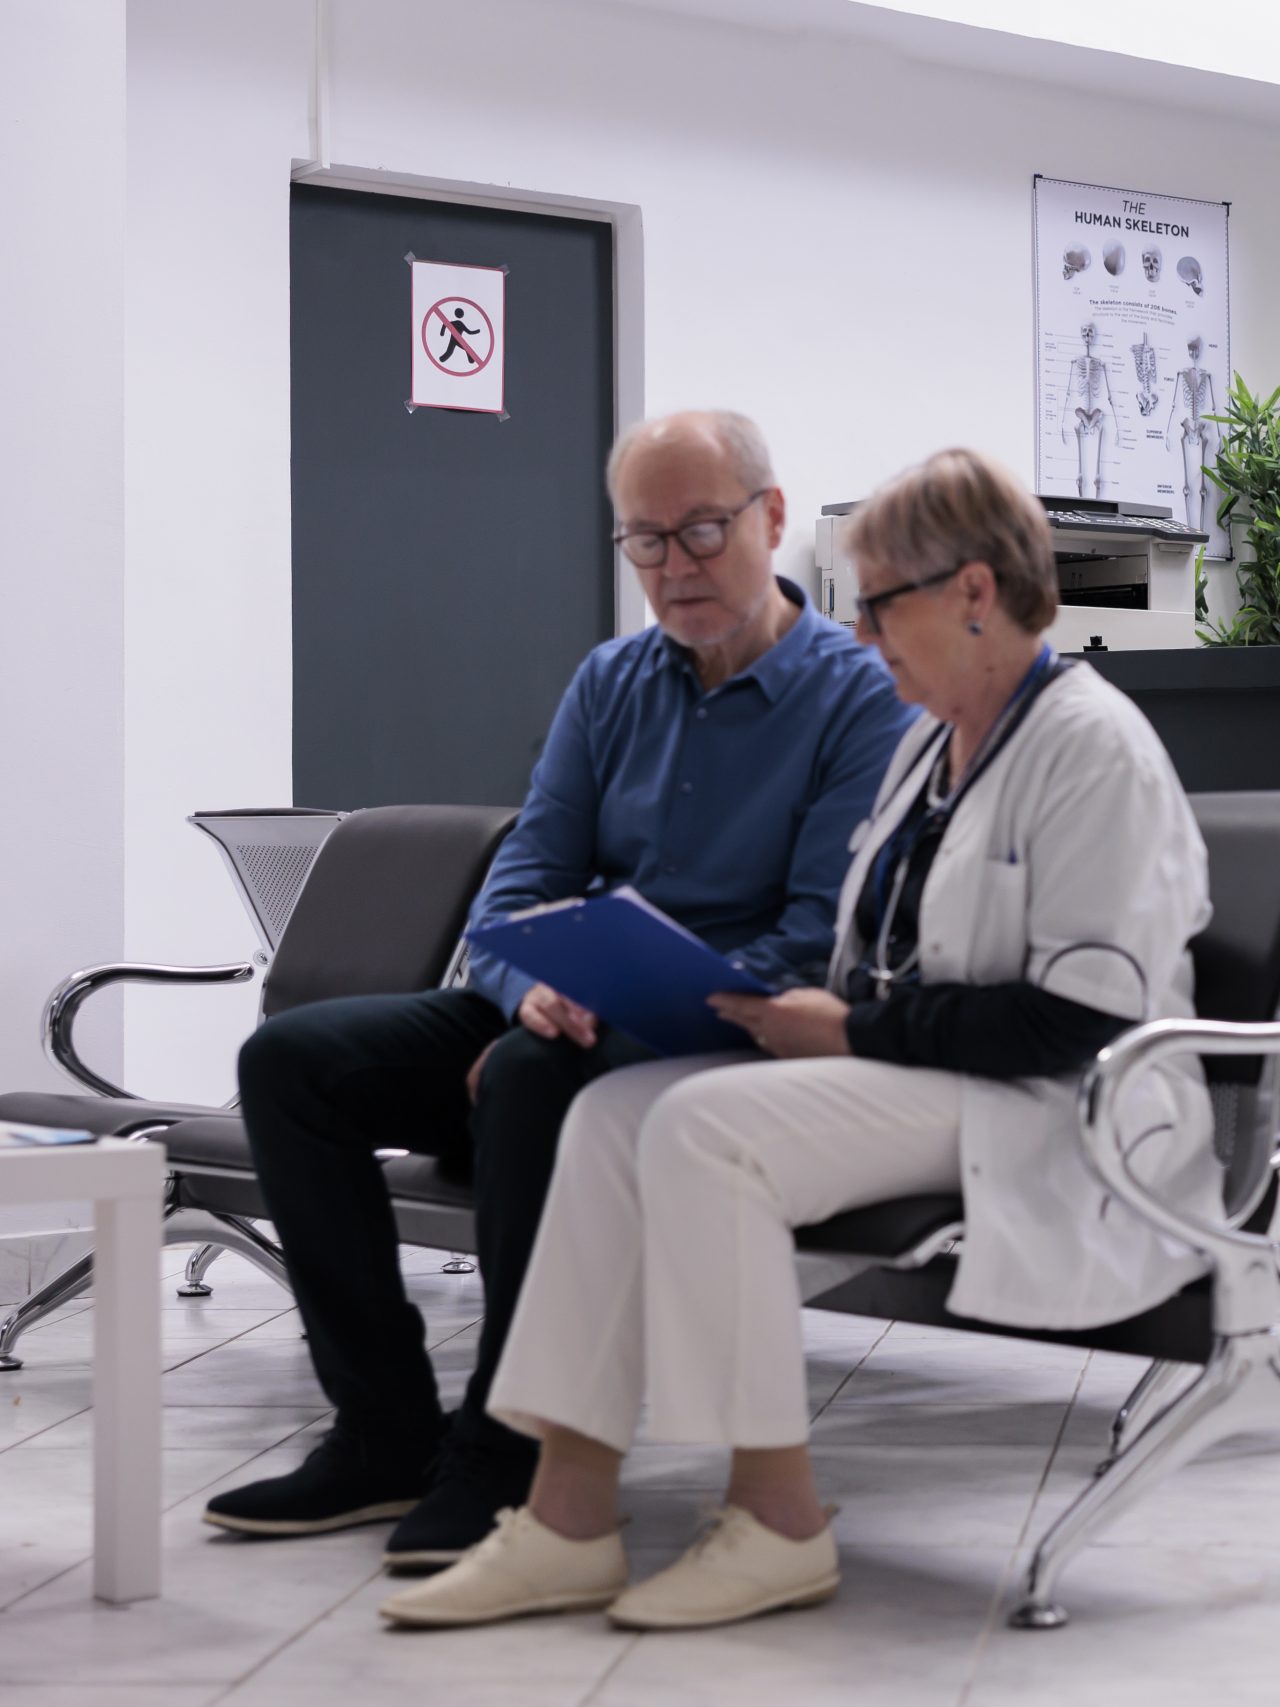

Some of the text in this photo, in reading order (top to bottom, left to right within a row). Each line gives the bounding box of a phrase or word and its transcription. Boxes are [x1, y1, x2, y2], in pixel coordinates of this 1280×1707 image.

[1122, 200, 1147, 215] THE
[1075, 211, 1190, 238] HUMAN SKELETON
